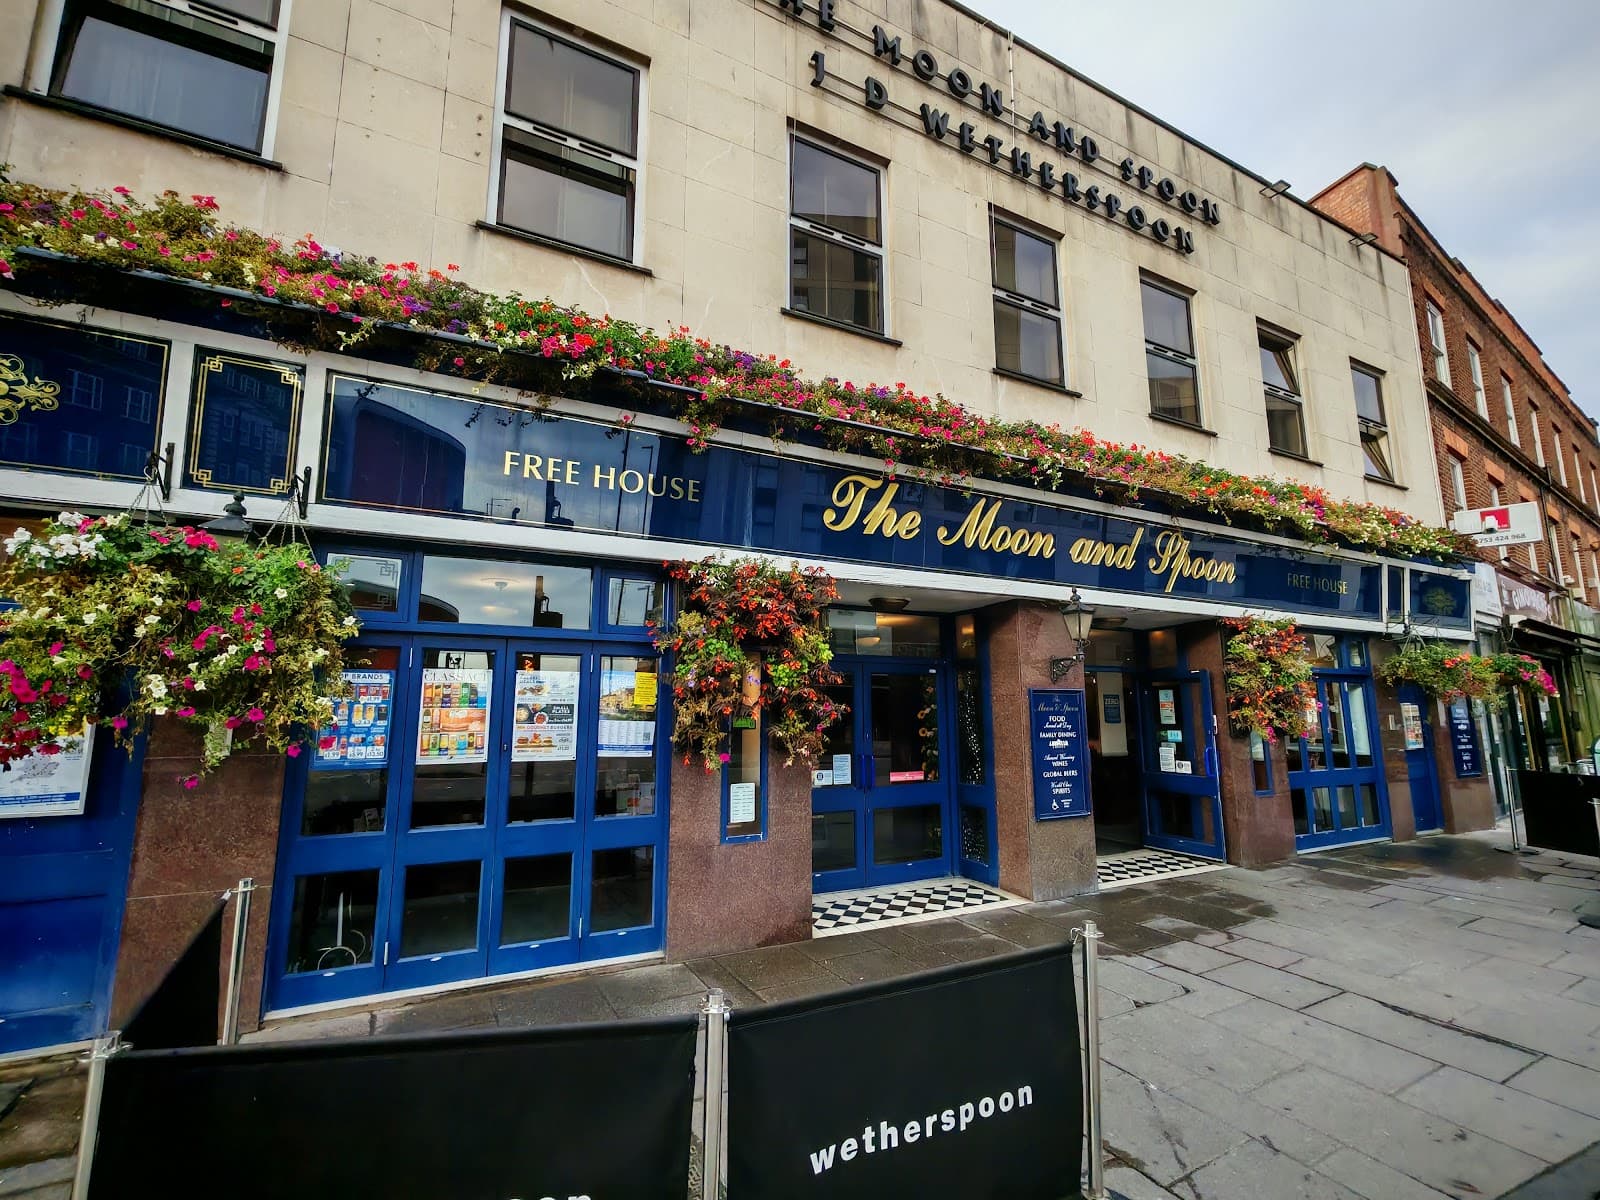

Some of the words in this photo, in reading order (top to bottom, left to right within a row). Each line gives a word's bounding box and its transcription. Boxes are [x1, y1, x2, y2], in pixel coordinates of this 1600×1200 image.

[808, 50, 825, 88] J
[864, 76, 888, 110] D
[919, 103, 1195, 254] WETHERSPOON
[871, 25, 1004, 117] MOON
[1028, 110, 1100, 163] AND
[1120, 157, 1220, 225] SPOON
[503, 450, 581, 485] FREE
[593, 464, 702, 503] HOUSE
[823, 474, 923, 541] The
[937, 495, 1056, 560] Moon
[1069, 527, 1146, 571] and
[1148, 529, 1237, 593] Spoon
[1287, 572, 1311, 589] FREE
[1313, 577, 1348, 595] HOUSE
[424, 671, 463, 681] CLASS
[1043, 770, 1063, 778] GLOBAL
[809, 1085, 1033, 1175] wetherspoon
